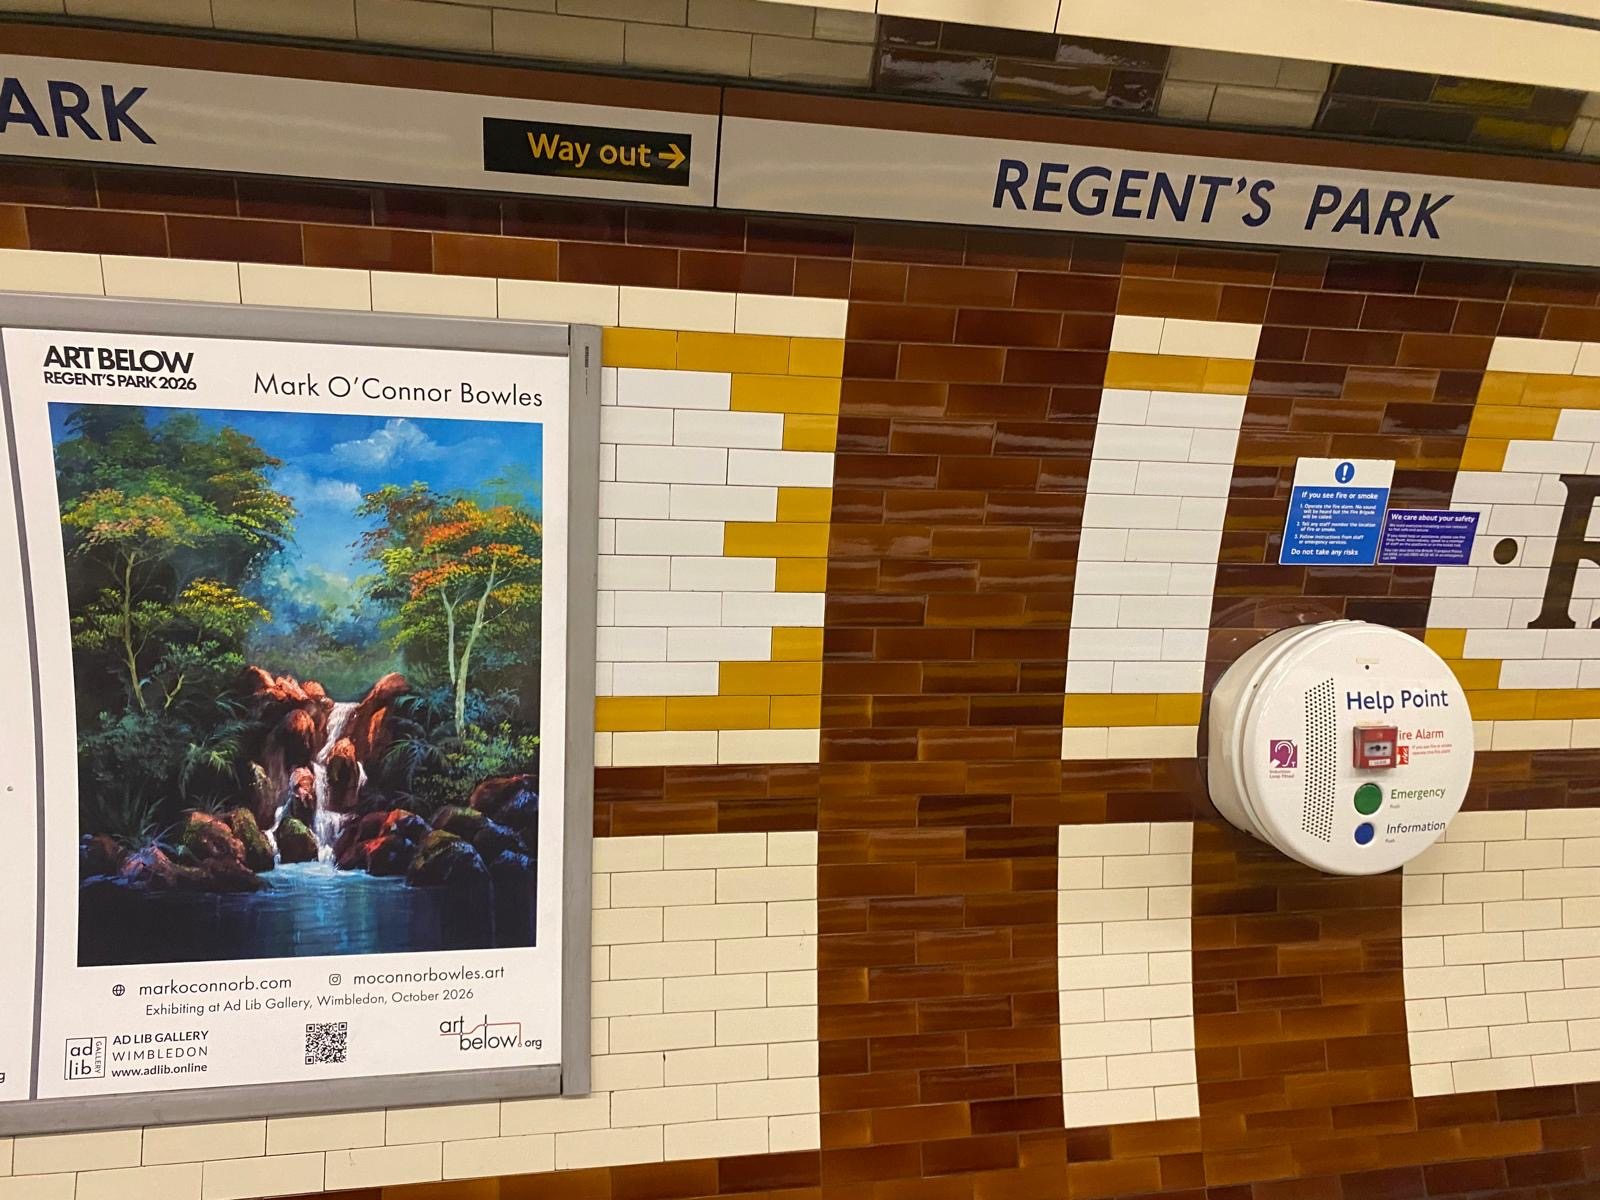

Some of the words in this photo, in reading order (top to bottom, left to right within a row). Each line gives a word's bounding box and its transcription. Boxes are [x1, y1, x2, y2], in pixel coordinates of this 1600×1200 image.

[0, 77, 157, 144] ARK
[527, 132, 591, 168] Way
[599, 143, 651, 167] out
[992, 158, 1275, 228] REGENT'S
[1304, 184, 1455, 240] PARK
[44, 346, 94, 369] ART
[99, 347, 195, 374] BELOW
[44, 371, 116, 387] REGENT'S
[118, 374, 157, 389] PARK
[158, 377, 197, 391] 2026
[254, 372, 320, 397] Mark
[328, 376, 452, 403] O'Connor
[460, 382, 543, 407] Bowles
[1308, 492, 1320, 500] you
[1438, 515, 1454, 523] your
[1455, 515, 1476, 523] safety
[1346, 690, 1395, 714] Help
[1400, 689, 1449, 709] Point
[1416, 728, 1444, 739] Alarm
[1391, 788, 1446, 800] Emergency
[1386, 821, 1446, 834] Information
[353, 965, 505, 985] moconnorbowles.art
[138, 976, 292, 996] markoconnorb.com
[146, 1003, 205, 1016] Exhibiting
[208, 1003, 220, 1013] at
[223, 999, 240, 1012] Ad
[245, 998, 262, 1010] Lib
[265, 997, 313, 1010] Gallery,
[317, 993, 388, 1006] Wimbledon,
[391, 990, 440, 1003] October
[442, 989, 474, 1001] 2026
[440, 1016, 464, 1033] art
[70, 1037, 93, 1056] ad
[112, 1035, 131, 1045] AD
[134, 1034, 152, 1044] LIB
[154, 1030, 209, 1042] GALLERY
[94, 1041, 102, 1074] GALLERY
[112, 1046, 208, 1061] WIMBLEDON
[69, 1059, 92, 1080] lib
[111, 1062, 208, 1077] www.adlib.online
